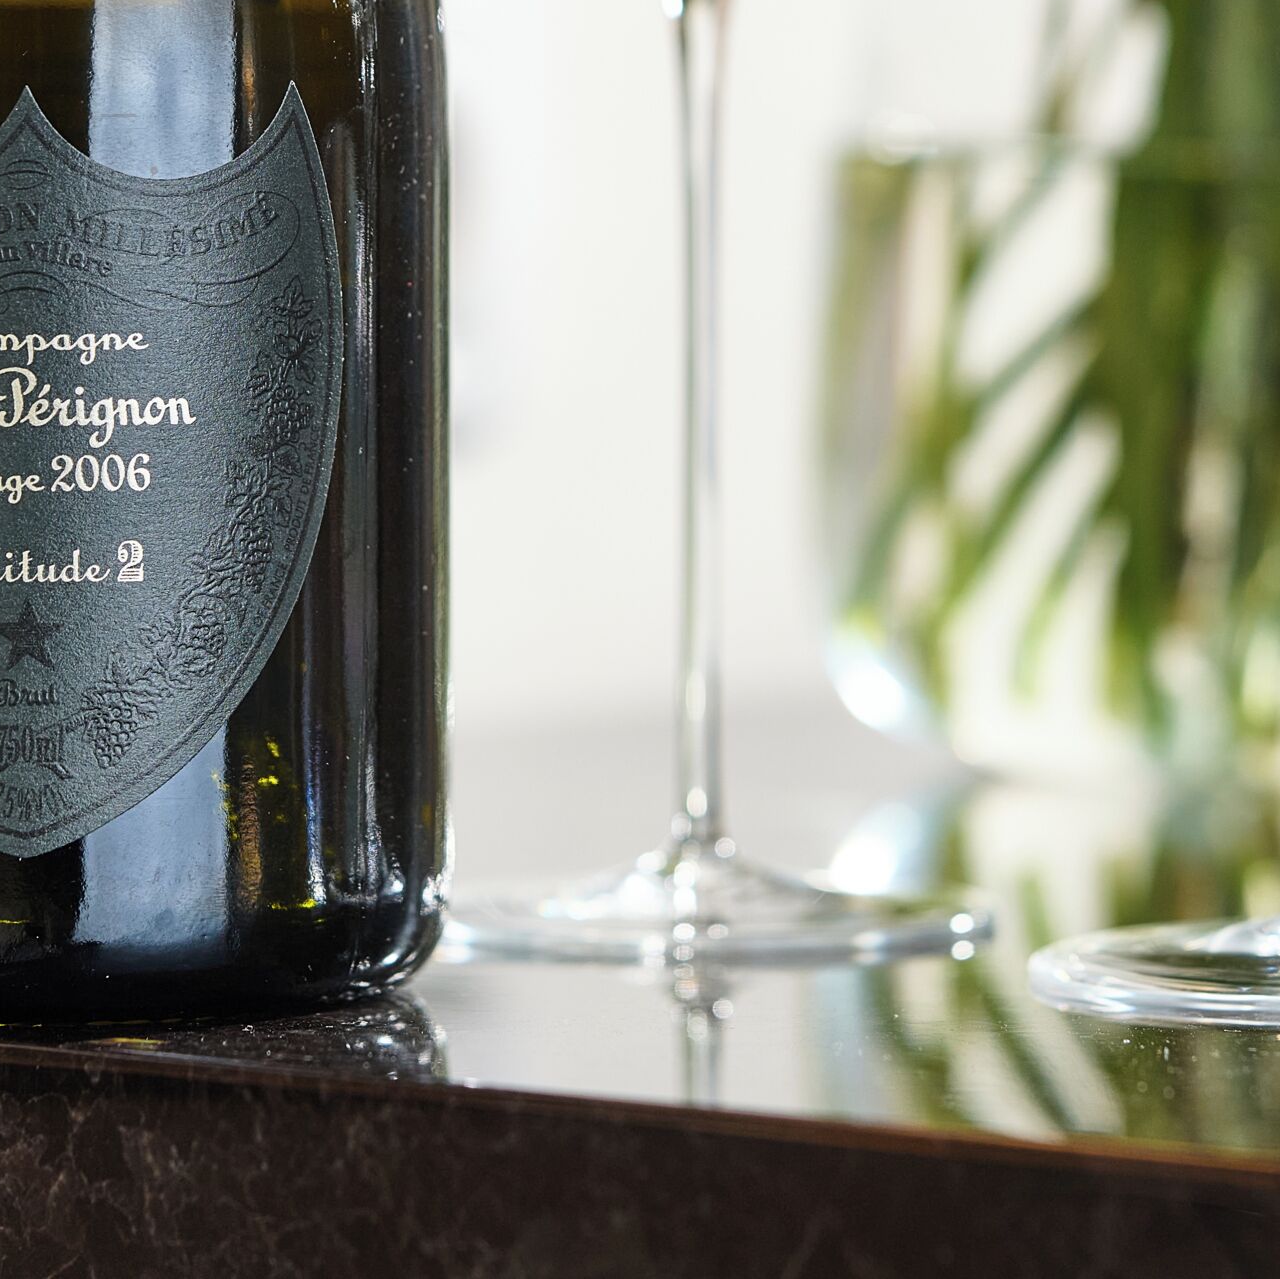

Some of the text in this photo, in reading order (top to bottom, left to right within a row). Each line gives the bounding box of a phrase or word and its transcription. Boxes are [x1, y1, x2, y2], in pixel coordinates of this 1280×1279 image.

[50, 453, 151, 492] 2006
[283, 497, 306, 552] PRODUIT
[299, 477, 311, 495] DE
[117, 540, 144, 582] 2
